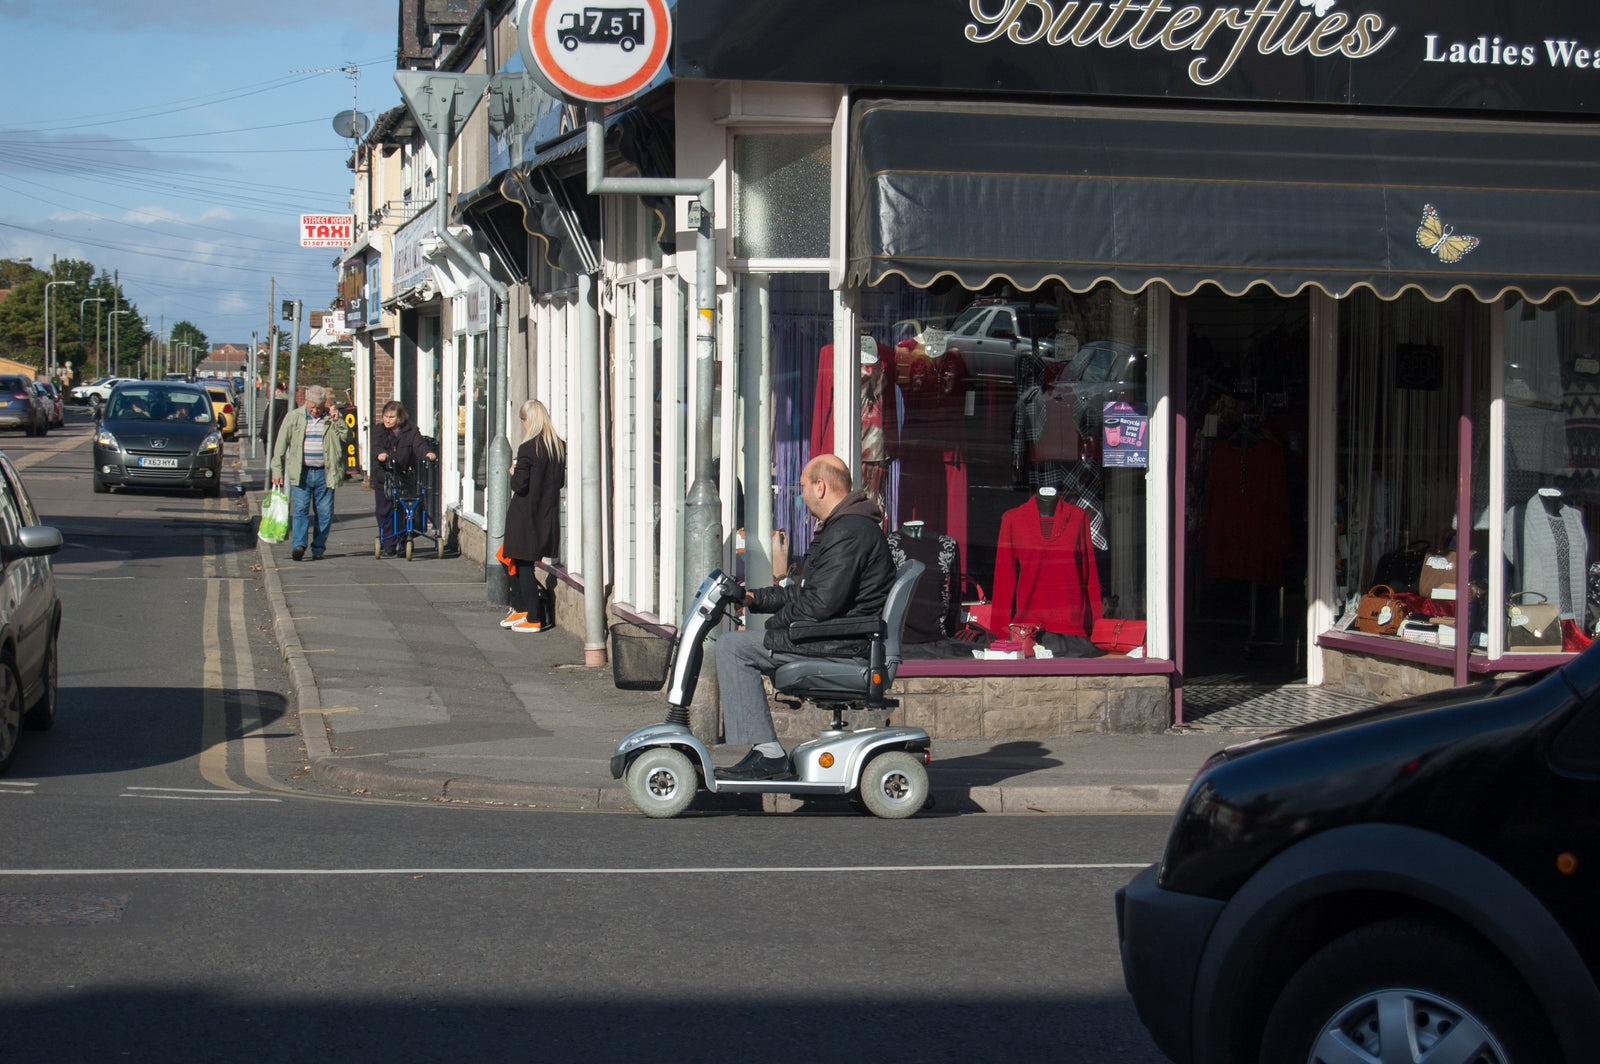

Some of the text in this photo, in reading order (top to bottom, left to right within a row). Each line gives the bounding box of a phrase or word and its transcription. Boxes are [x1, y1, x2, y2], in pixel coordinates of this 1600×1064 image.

[964, 0, 1396, 86] Butterflies
[1423, 35, 1535, 66] Ladies
[303, 216, 329, 224] STREET
[305, 225, 350, 238] TAXI
[1120, 418, 1140, 427] Recycle
[345, 413, 356, 467] Oen
[1126, 455, 1146, 464] Royce
